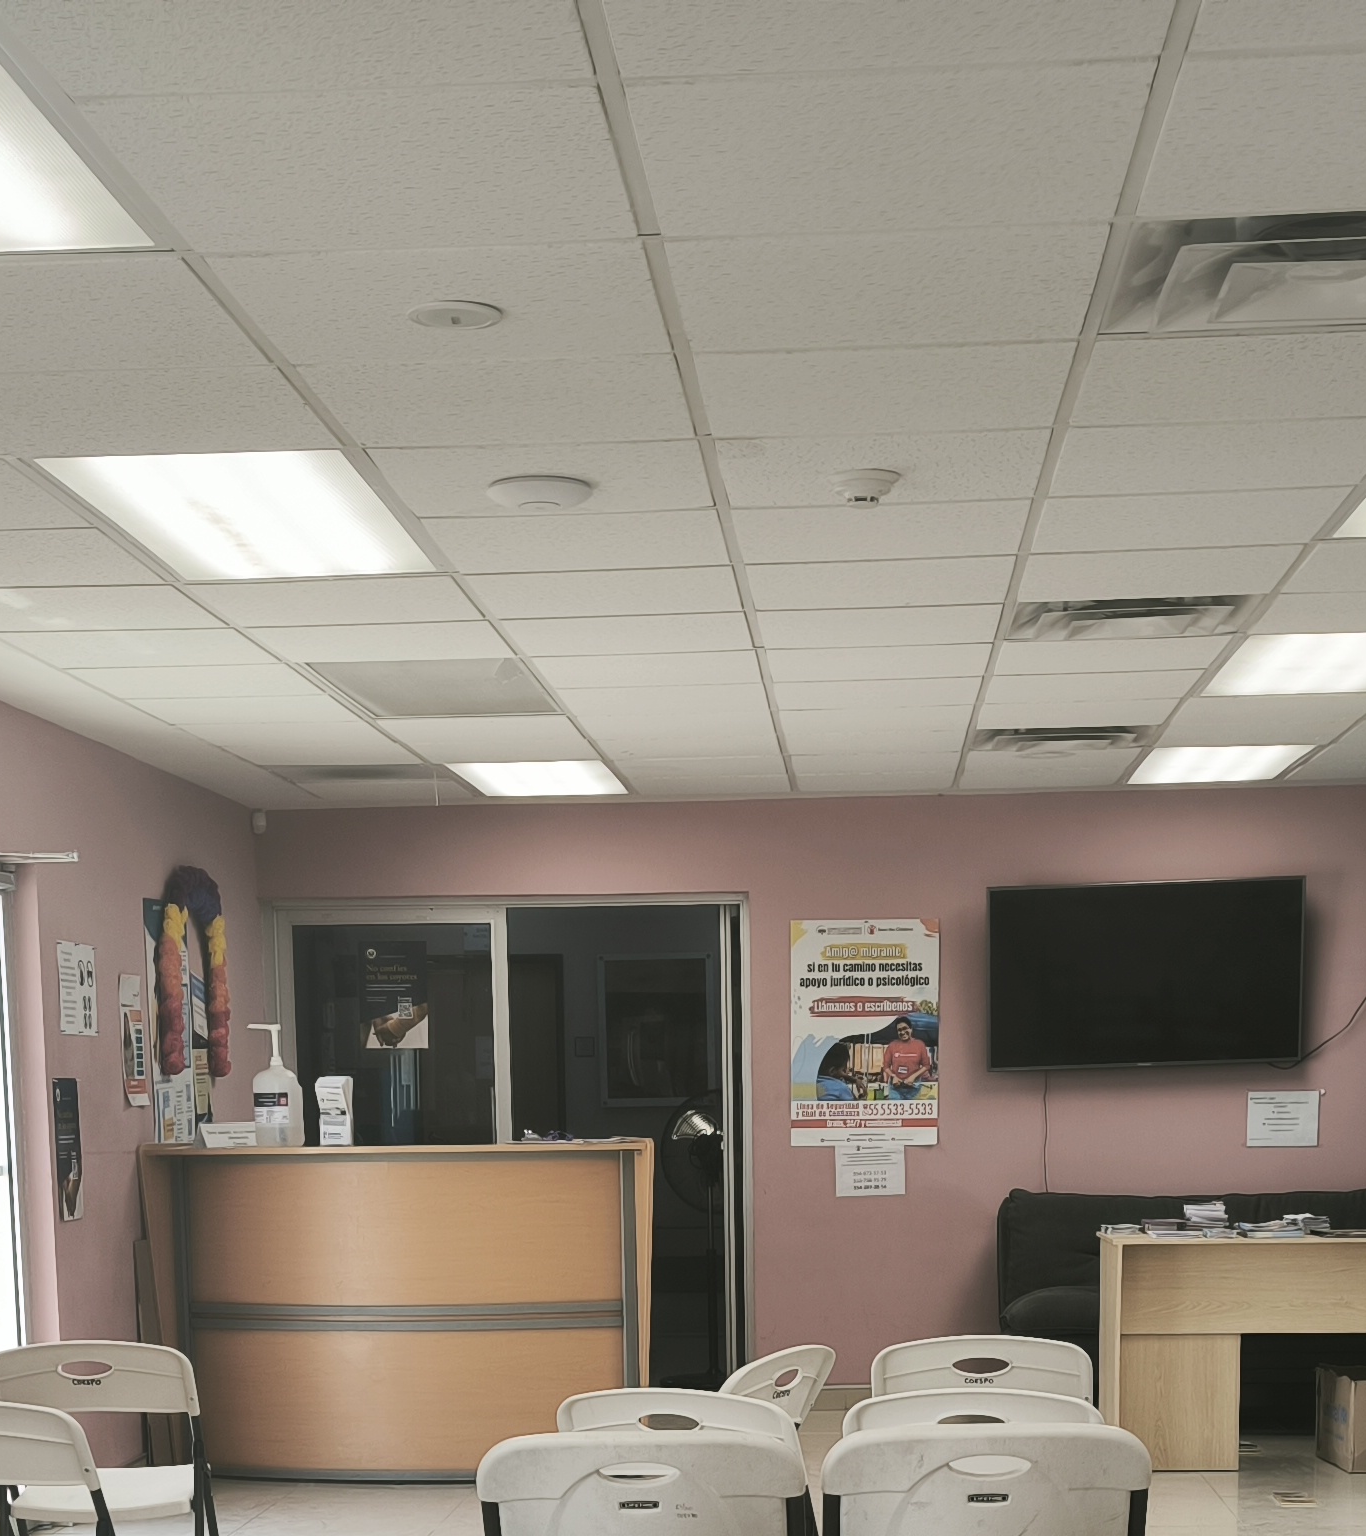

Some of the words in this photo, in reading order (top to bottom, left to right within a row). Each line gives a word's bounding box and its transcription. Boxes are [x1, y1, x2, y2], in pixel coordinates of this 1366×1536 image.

[825, 946, 858, 958] Amig@
[807, 962, 815, 972] si
[818, 964, 829, 972] en
[832, 962, 841, 972] tu
[843, 961, 875, 972] camino
[879, 960, 923, 972] necesitas
[799, 976, 827, 988] apoyo
[830, 974, 865, 988] jurídico
[867, 976, 873, 986] o
[876, 974, 930, 988] psicológico
[815, 1000, 855, 1012] Llámanos
[857, 1002, 863, 1010] o
[865, 1000, 913, 1012] escríbenos
[964, 1377, 995, 1385] COESPO
